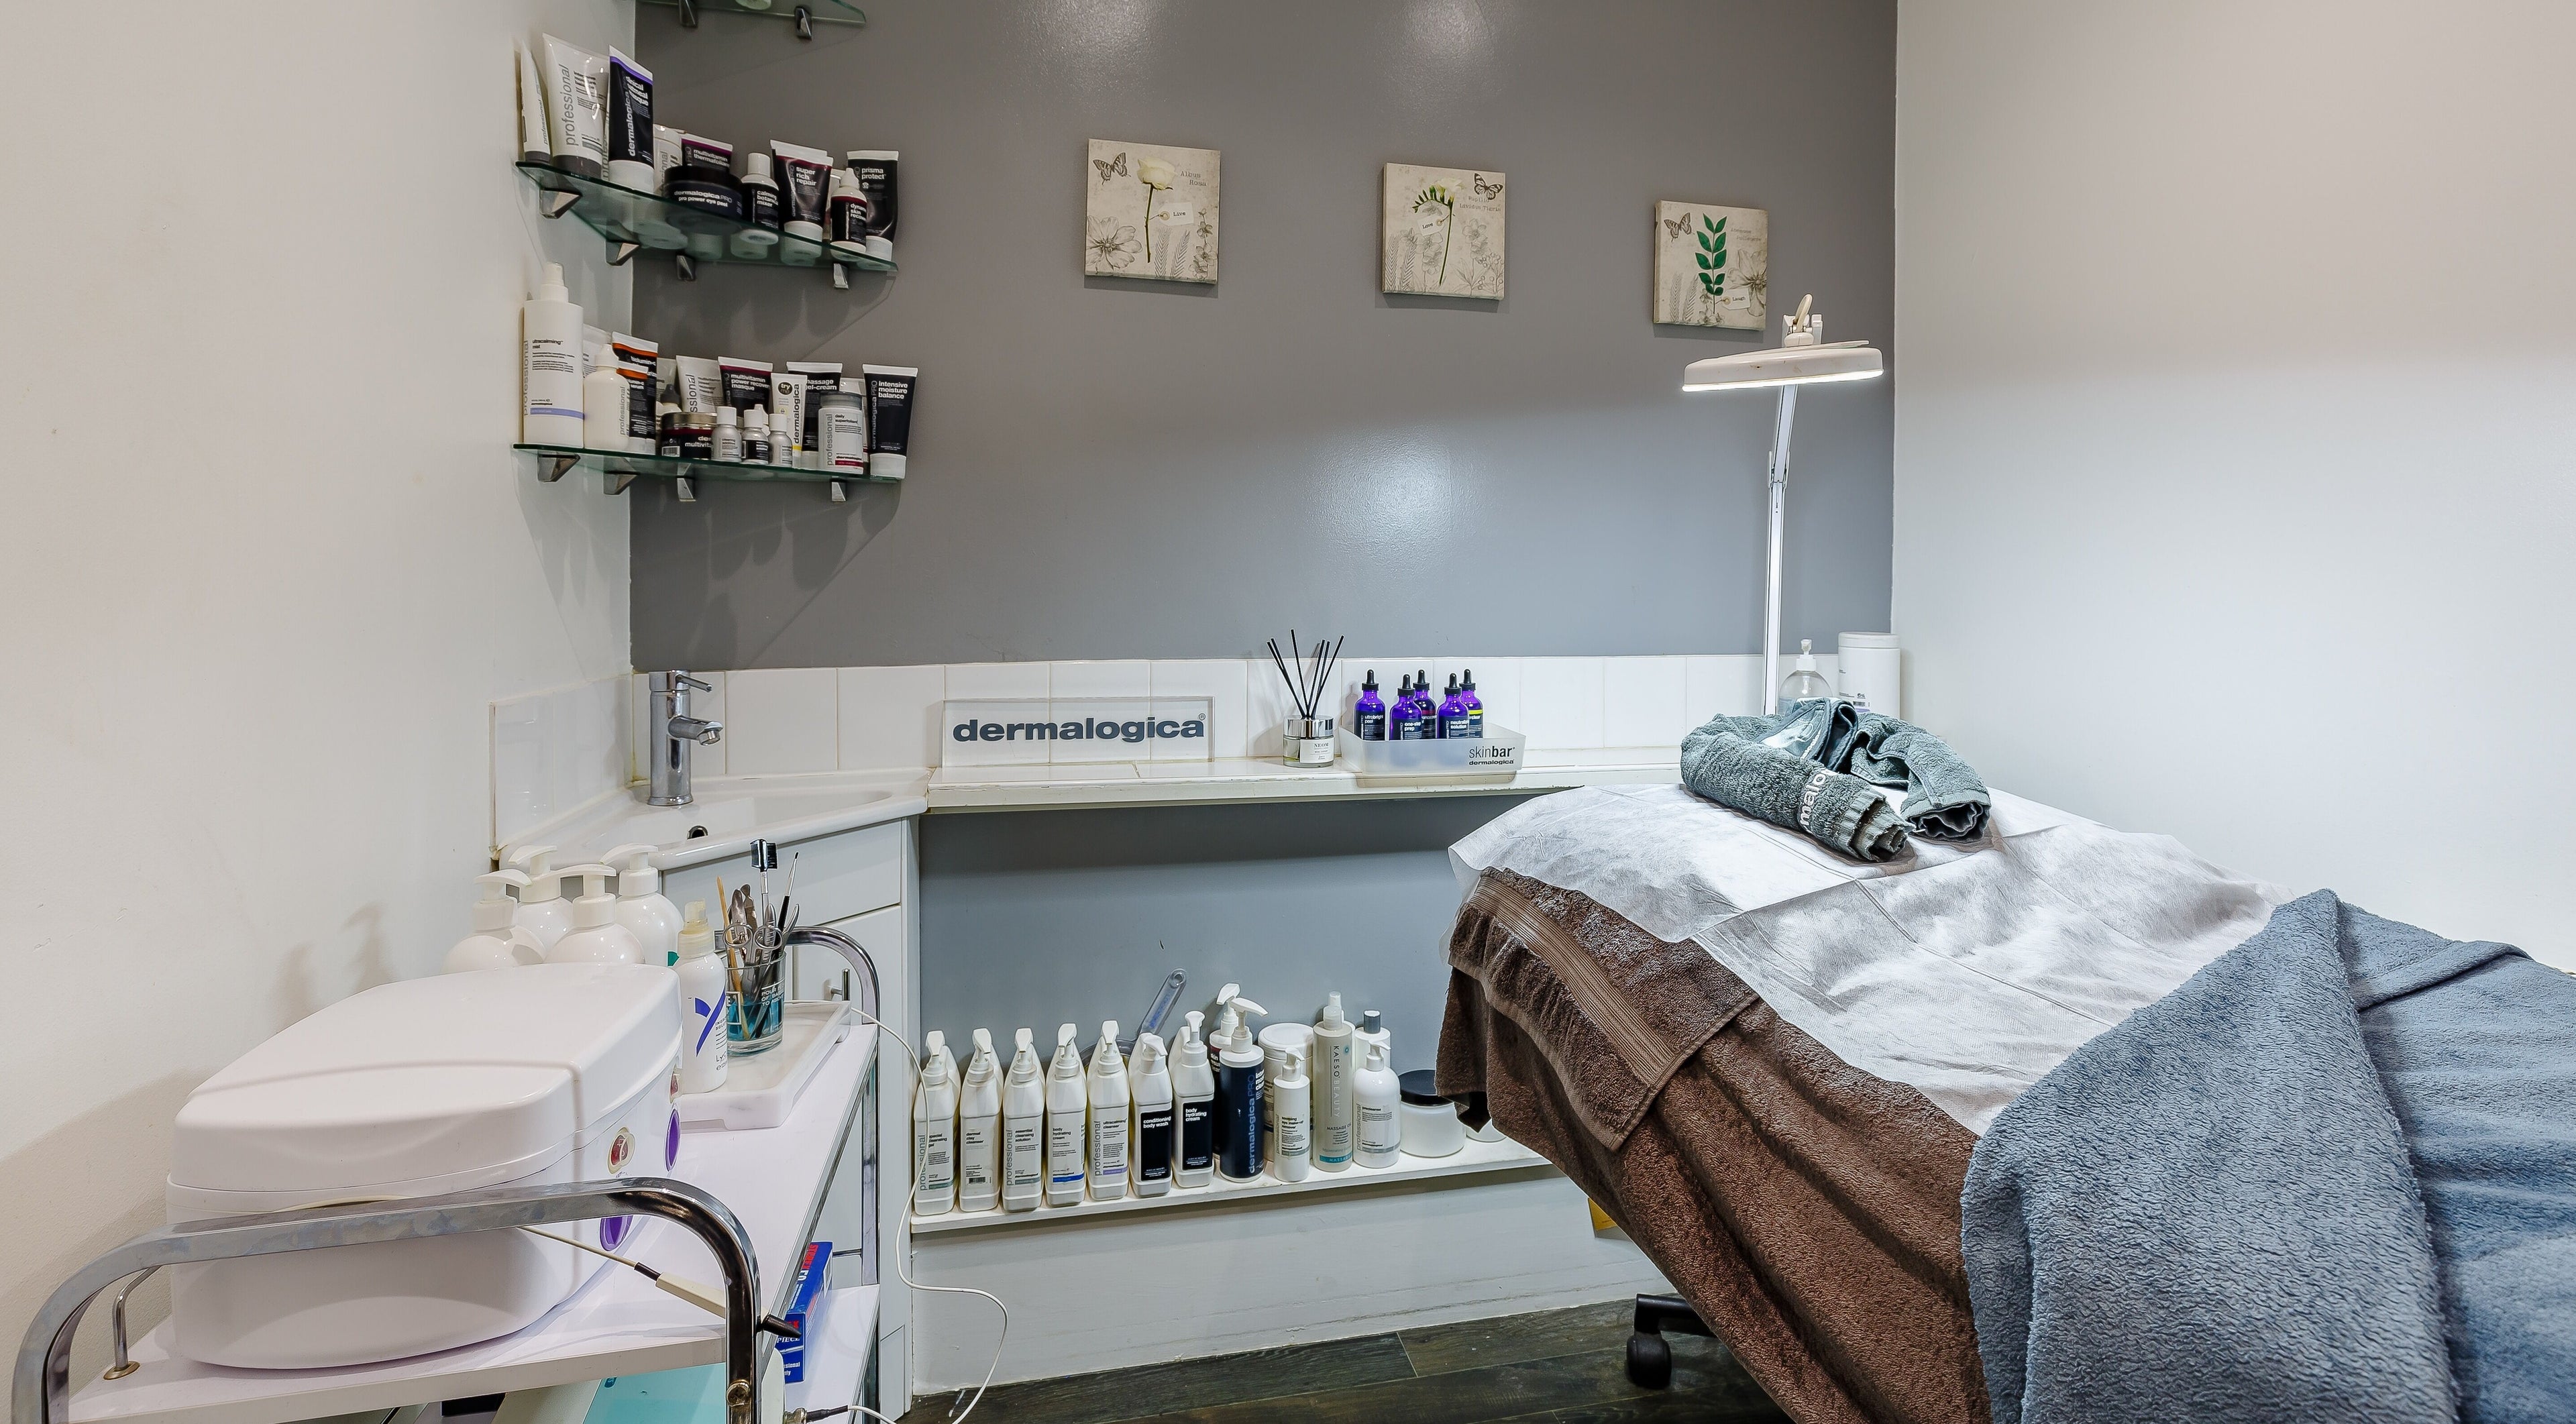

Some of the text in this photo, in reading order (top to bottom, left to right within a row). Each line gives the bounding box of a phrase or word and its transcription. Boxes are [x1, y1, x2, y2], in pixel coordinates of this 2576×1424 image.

[559, 64, 579, 146] professional
[625, 91, 636, 157] dermalogica
[693, 149, 729, 162] multivitamin
[796, 166, 816, 175] super
[796, 172, 810, 180] rich
[796, 178, 817, 186] repair
[674, 190, 733, 203] dermalogica PRO
[757, 190, 777, 201] calming
[731, 374, 766, 383] multivitamin
[793, 384, 801, 444] dermalogica
[826, 414, 834, 466] professional
[761, 986, 776, 996] POUR
[1143, 1115, 1171, 1124] conditioning
[1248, 1097, 1256, 1174] dermalogica
[1093, 1121, 1102, 1176] professional
[1006, 1130, 1014, 1186] professional
